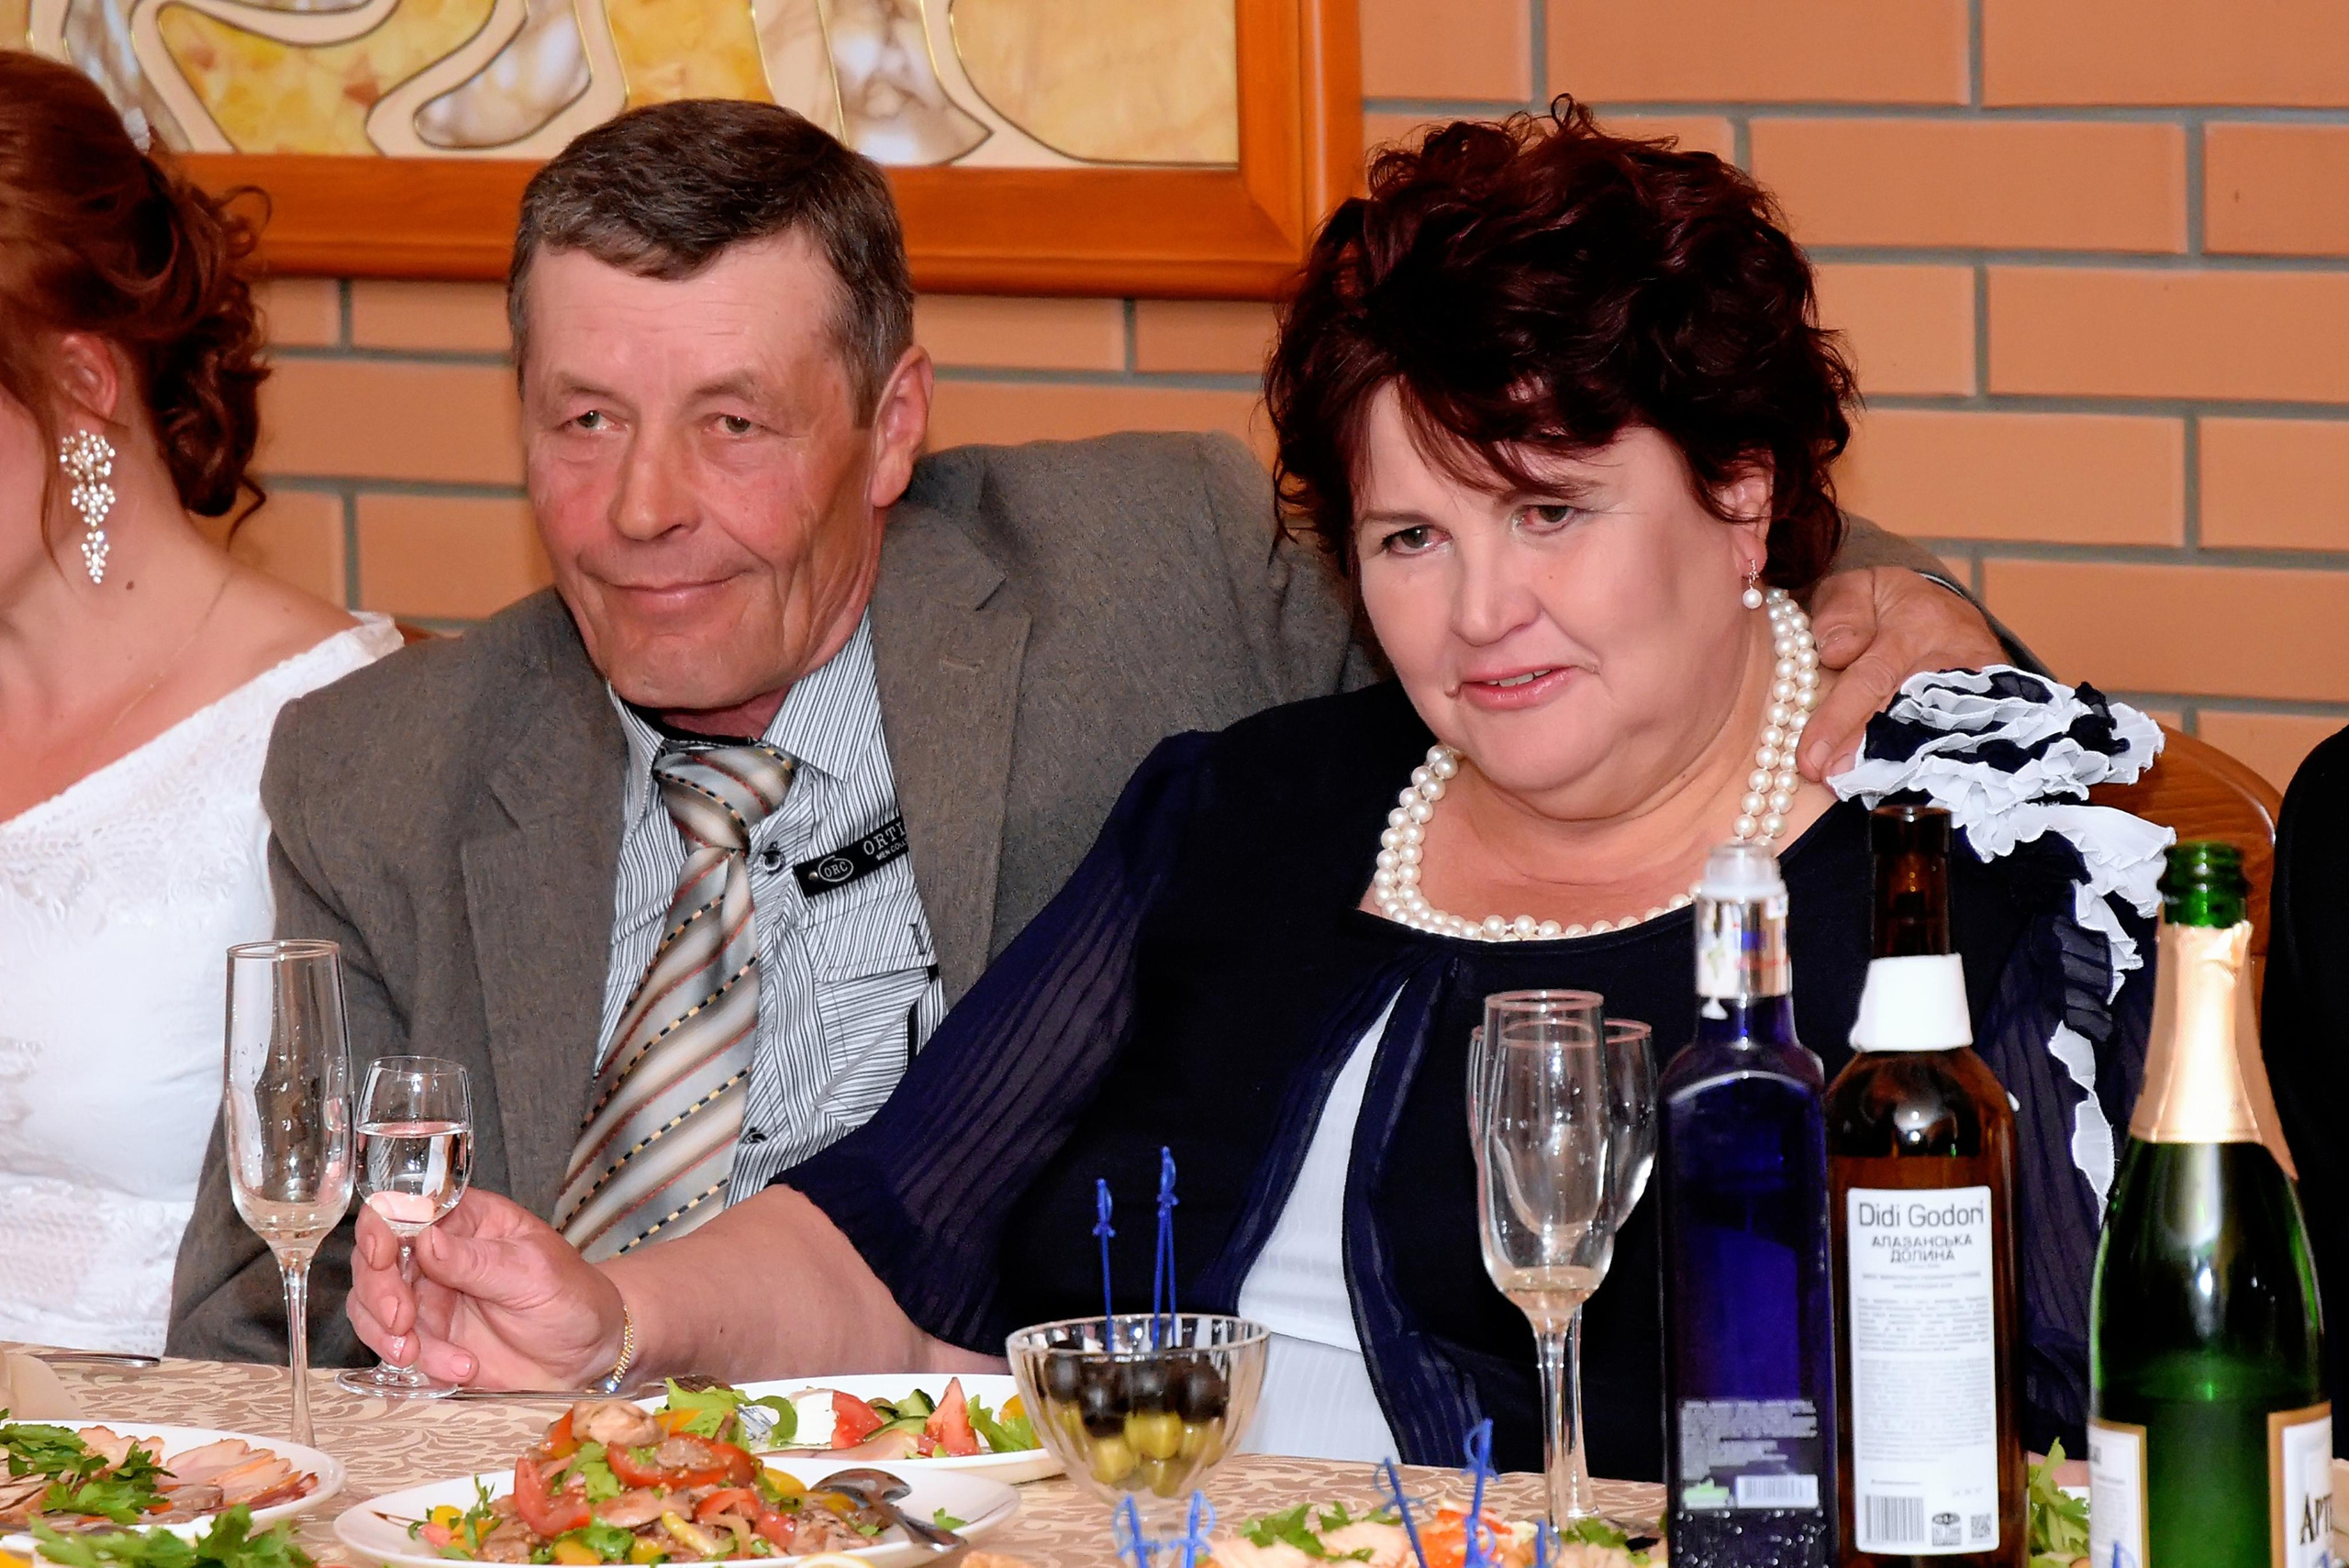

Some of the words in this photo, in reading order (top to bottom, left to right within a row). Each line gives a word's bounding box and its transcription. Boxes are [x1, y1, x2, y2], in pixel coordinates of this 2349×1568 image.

[863, 821, 906, 855] ORTI
[824, 861, 848, 878] ORC
[1859, 1202, 1900, 1228] Didi
[1872, 1234, 1972, 1248] АЛАЗАНСЬКА
[1890, 1250, 1955, 1263] ДОЛИНА
